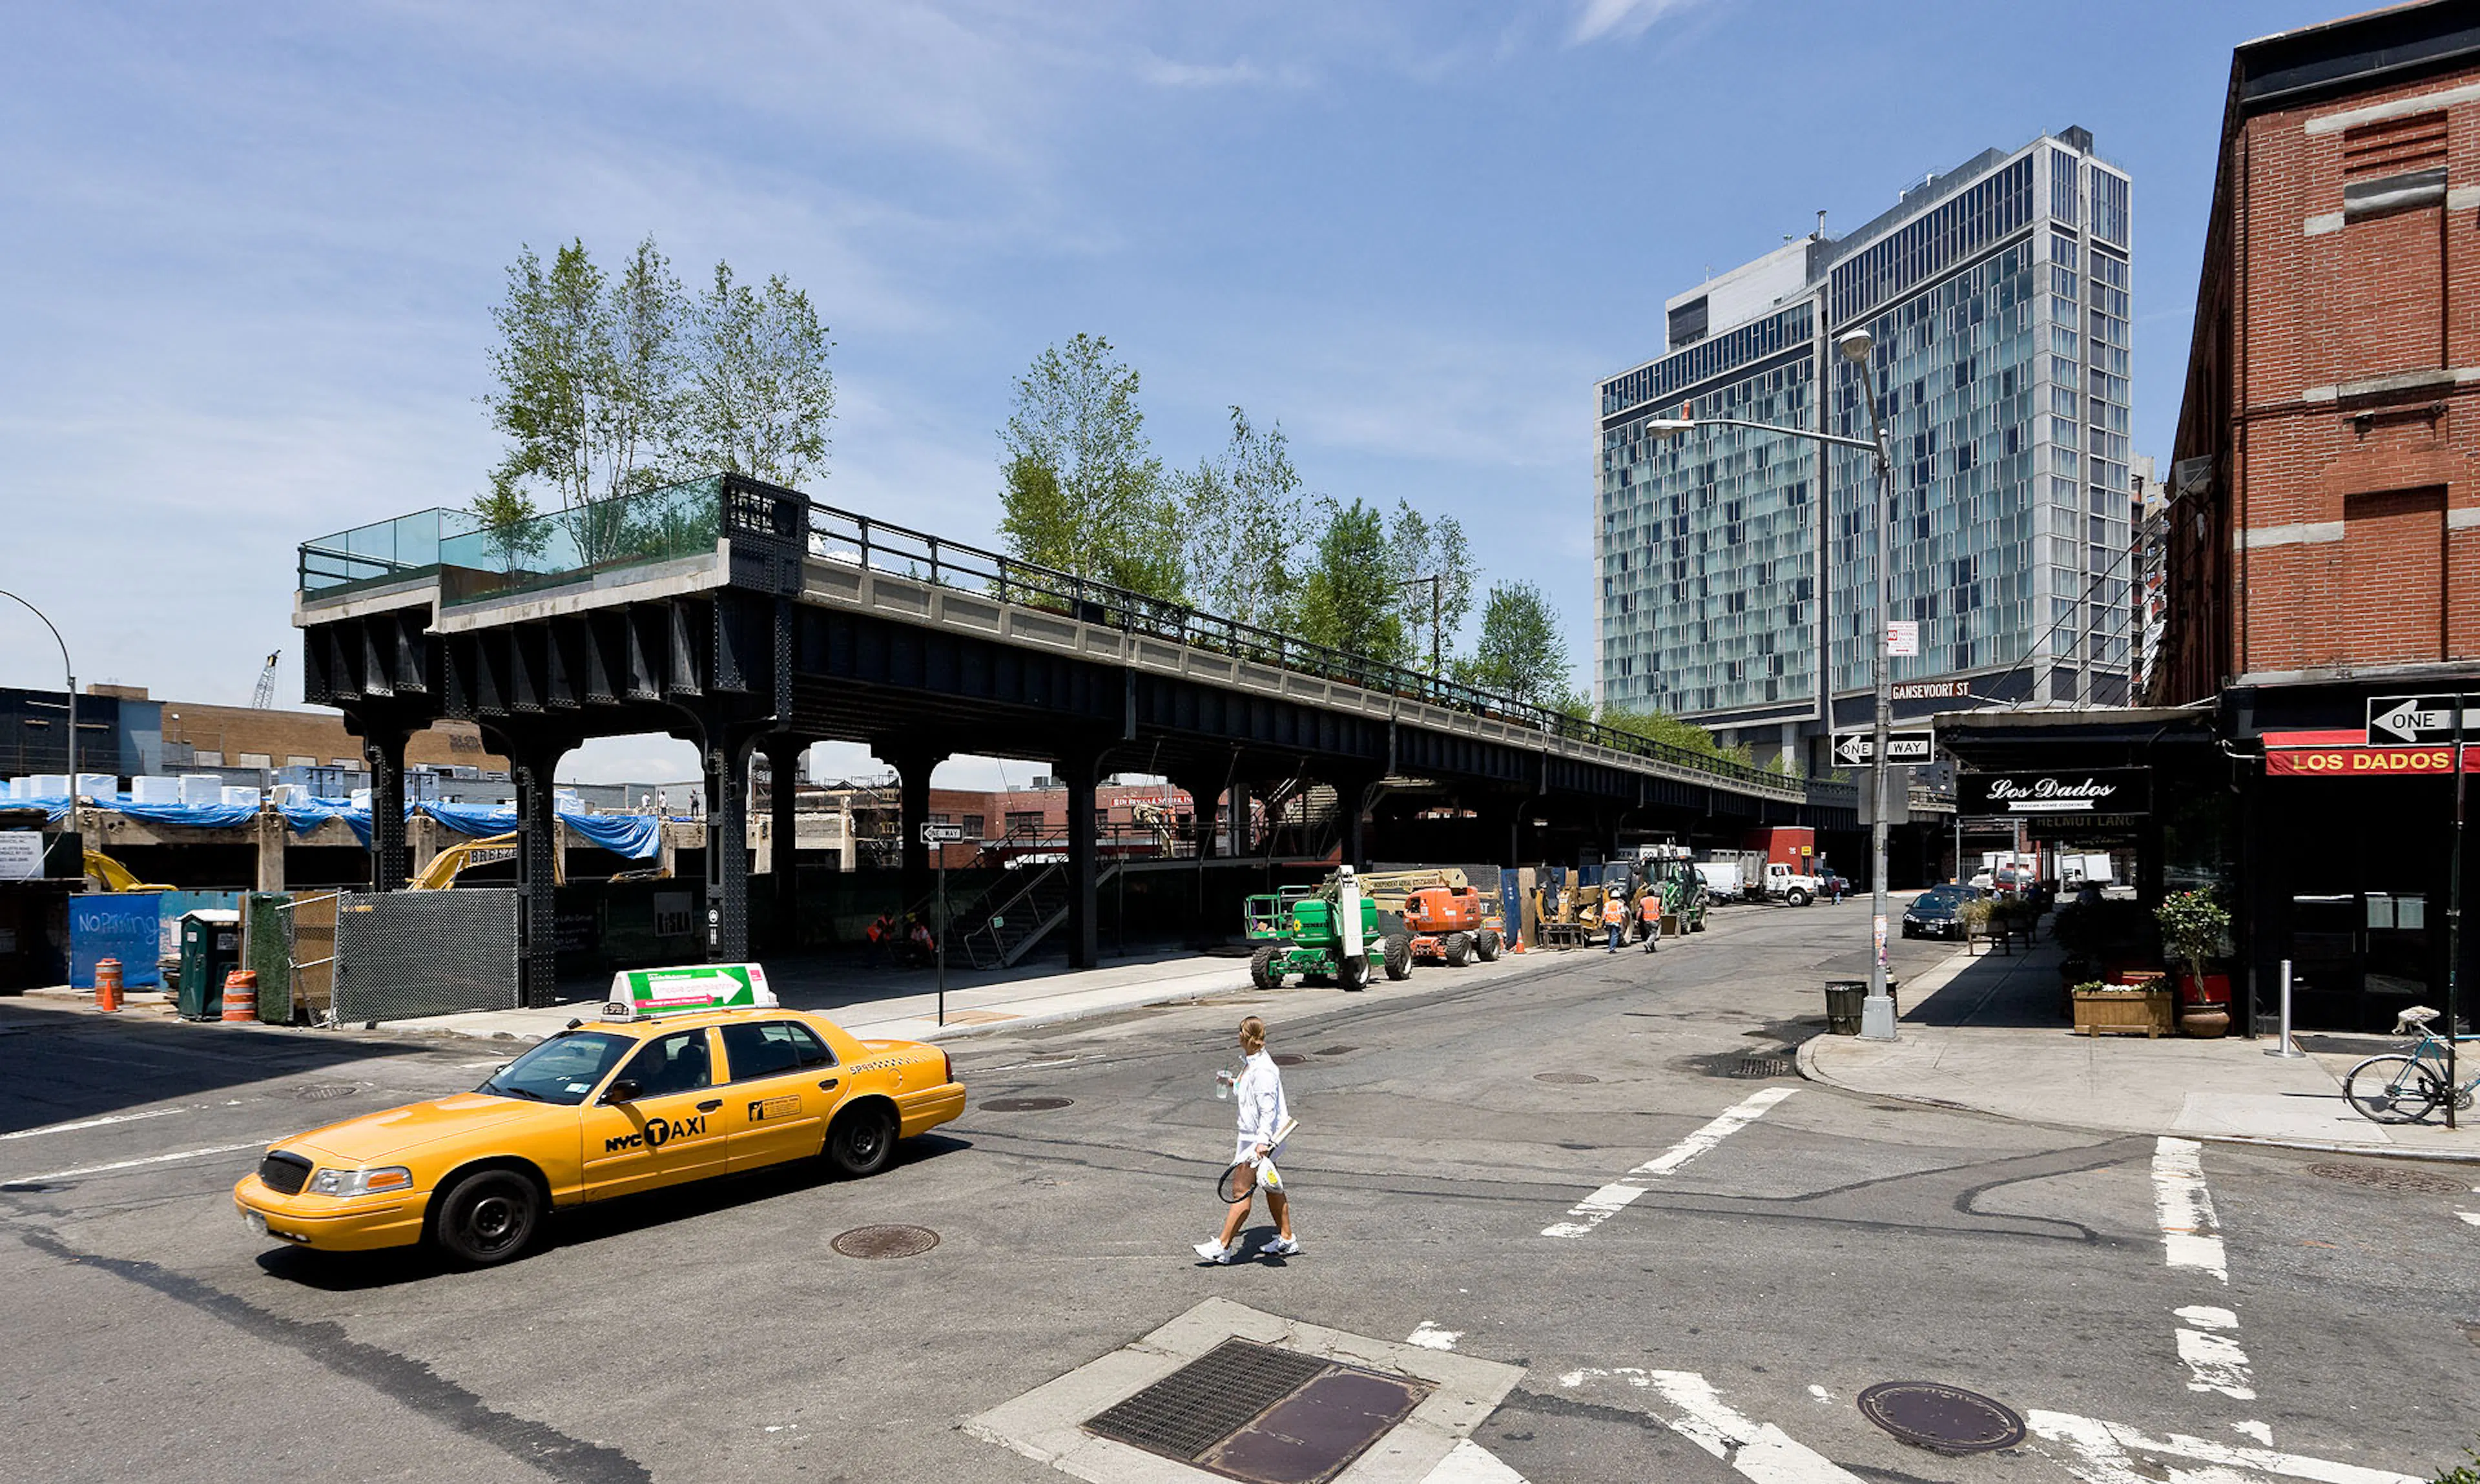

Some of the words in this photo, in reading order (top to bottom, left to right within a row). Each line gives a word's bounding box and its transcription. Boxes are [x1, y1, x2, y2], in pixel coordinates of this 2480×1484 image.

[1892, 683, 1954, 699] GANSEVOORT
[1956, 682, 1969, 696] ST
[2393, 714, 2435, 728] ONE
[1842, 743, 1869, 755] ONE
[1894, 743, 1921, 753] WAY
[2293, 754, 2344, 770] LOS
[2353, 752, 2450, 769] DADOS
[1986, 779, 2034, 799] Los
[2034, 778, 2116, 798] Dados
[2036, 816, 2091, 827] HELMUT
[2098, 816, 2134, 827] LANG
[605, 1133, 642, 1152] NYC
[646, 1116, 707, 1146] TAXI
